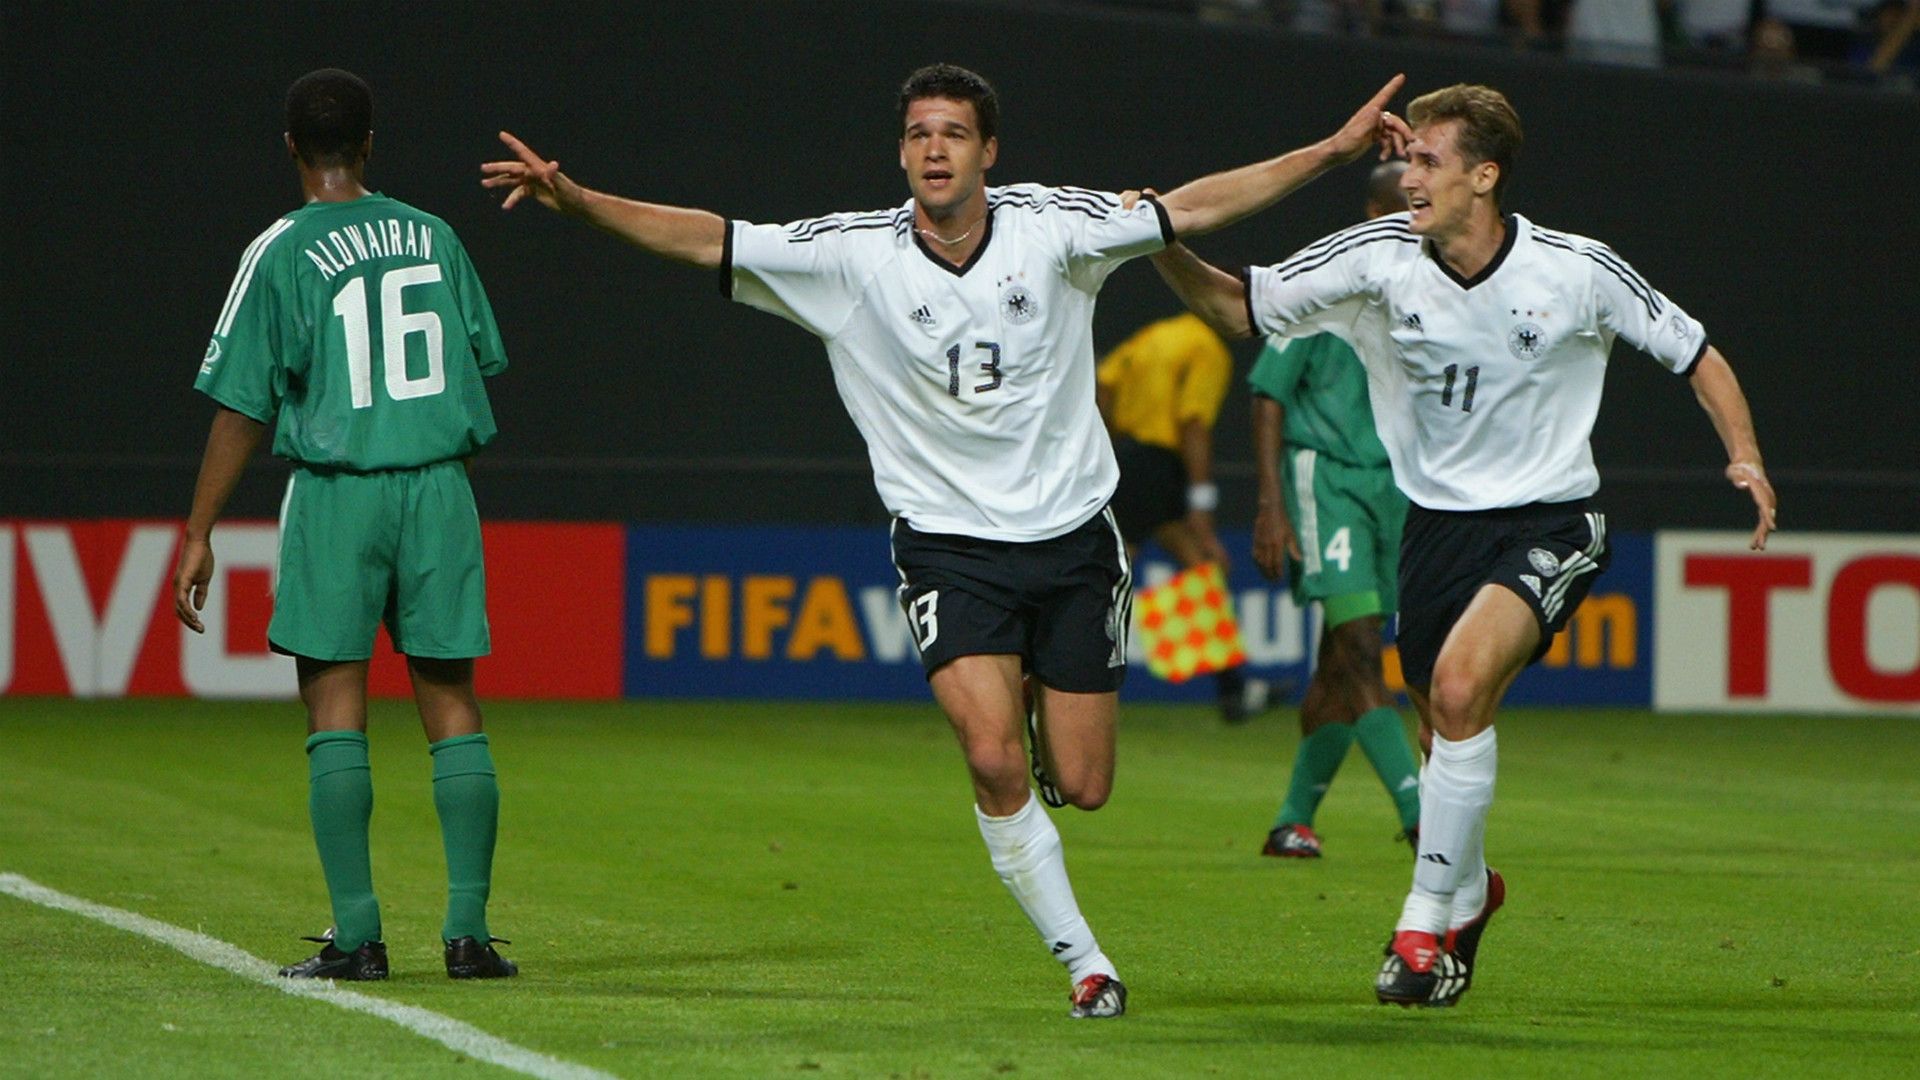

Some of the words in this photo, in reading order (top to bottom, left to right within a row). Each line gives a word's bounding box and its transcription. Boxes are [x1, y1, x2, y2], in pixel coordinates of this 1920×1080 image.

[333, 264, 446, 409] 16
[946, 341, 1002, 397] 13
[1440, 363, 1480, 413] 11
[1324, 526, 1352, 572] 4
[0, 524, 298, 697] VC
